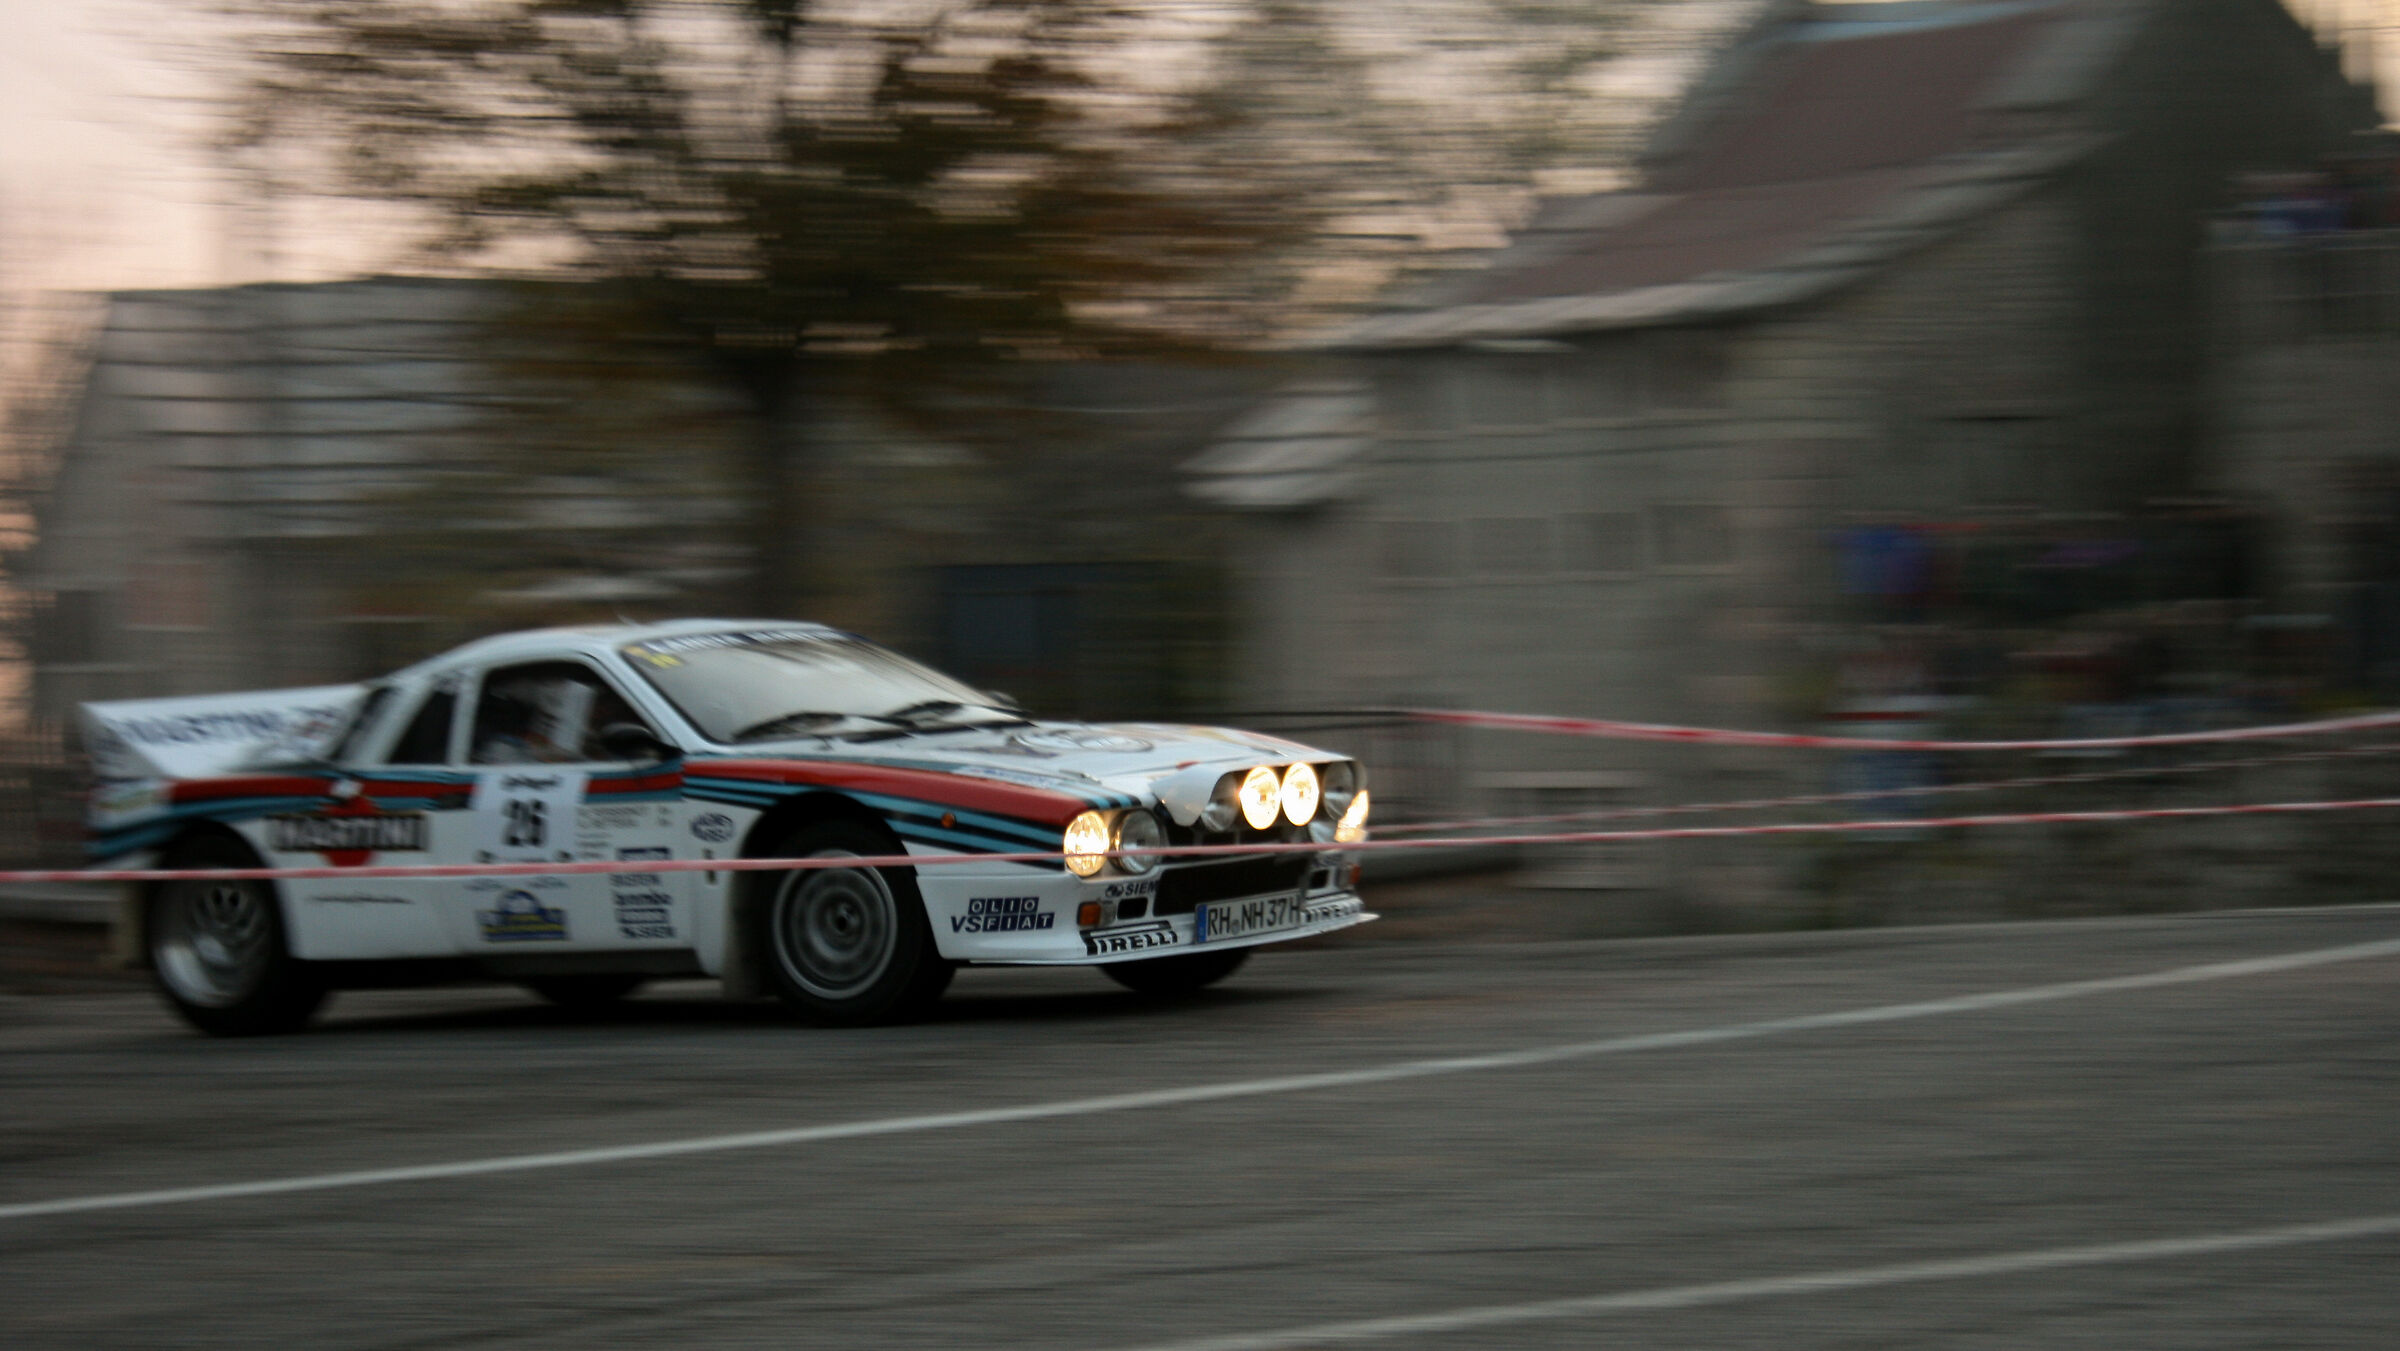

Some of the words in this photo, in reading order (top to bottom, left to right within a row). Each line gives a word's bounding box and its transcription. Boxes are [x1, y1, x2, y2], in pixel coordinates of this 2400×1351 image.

[275, 817, 427, 849] MARTINI
[502, 798, 547, 847] 26
[969, 898, 1038, 914] OLIO
[1207, 906, 1230, 936] RH
[1241, 901, 1264, 931] NH
[1080, 920, 1178, 956] PIRELLI
